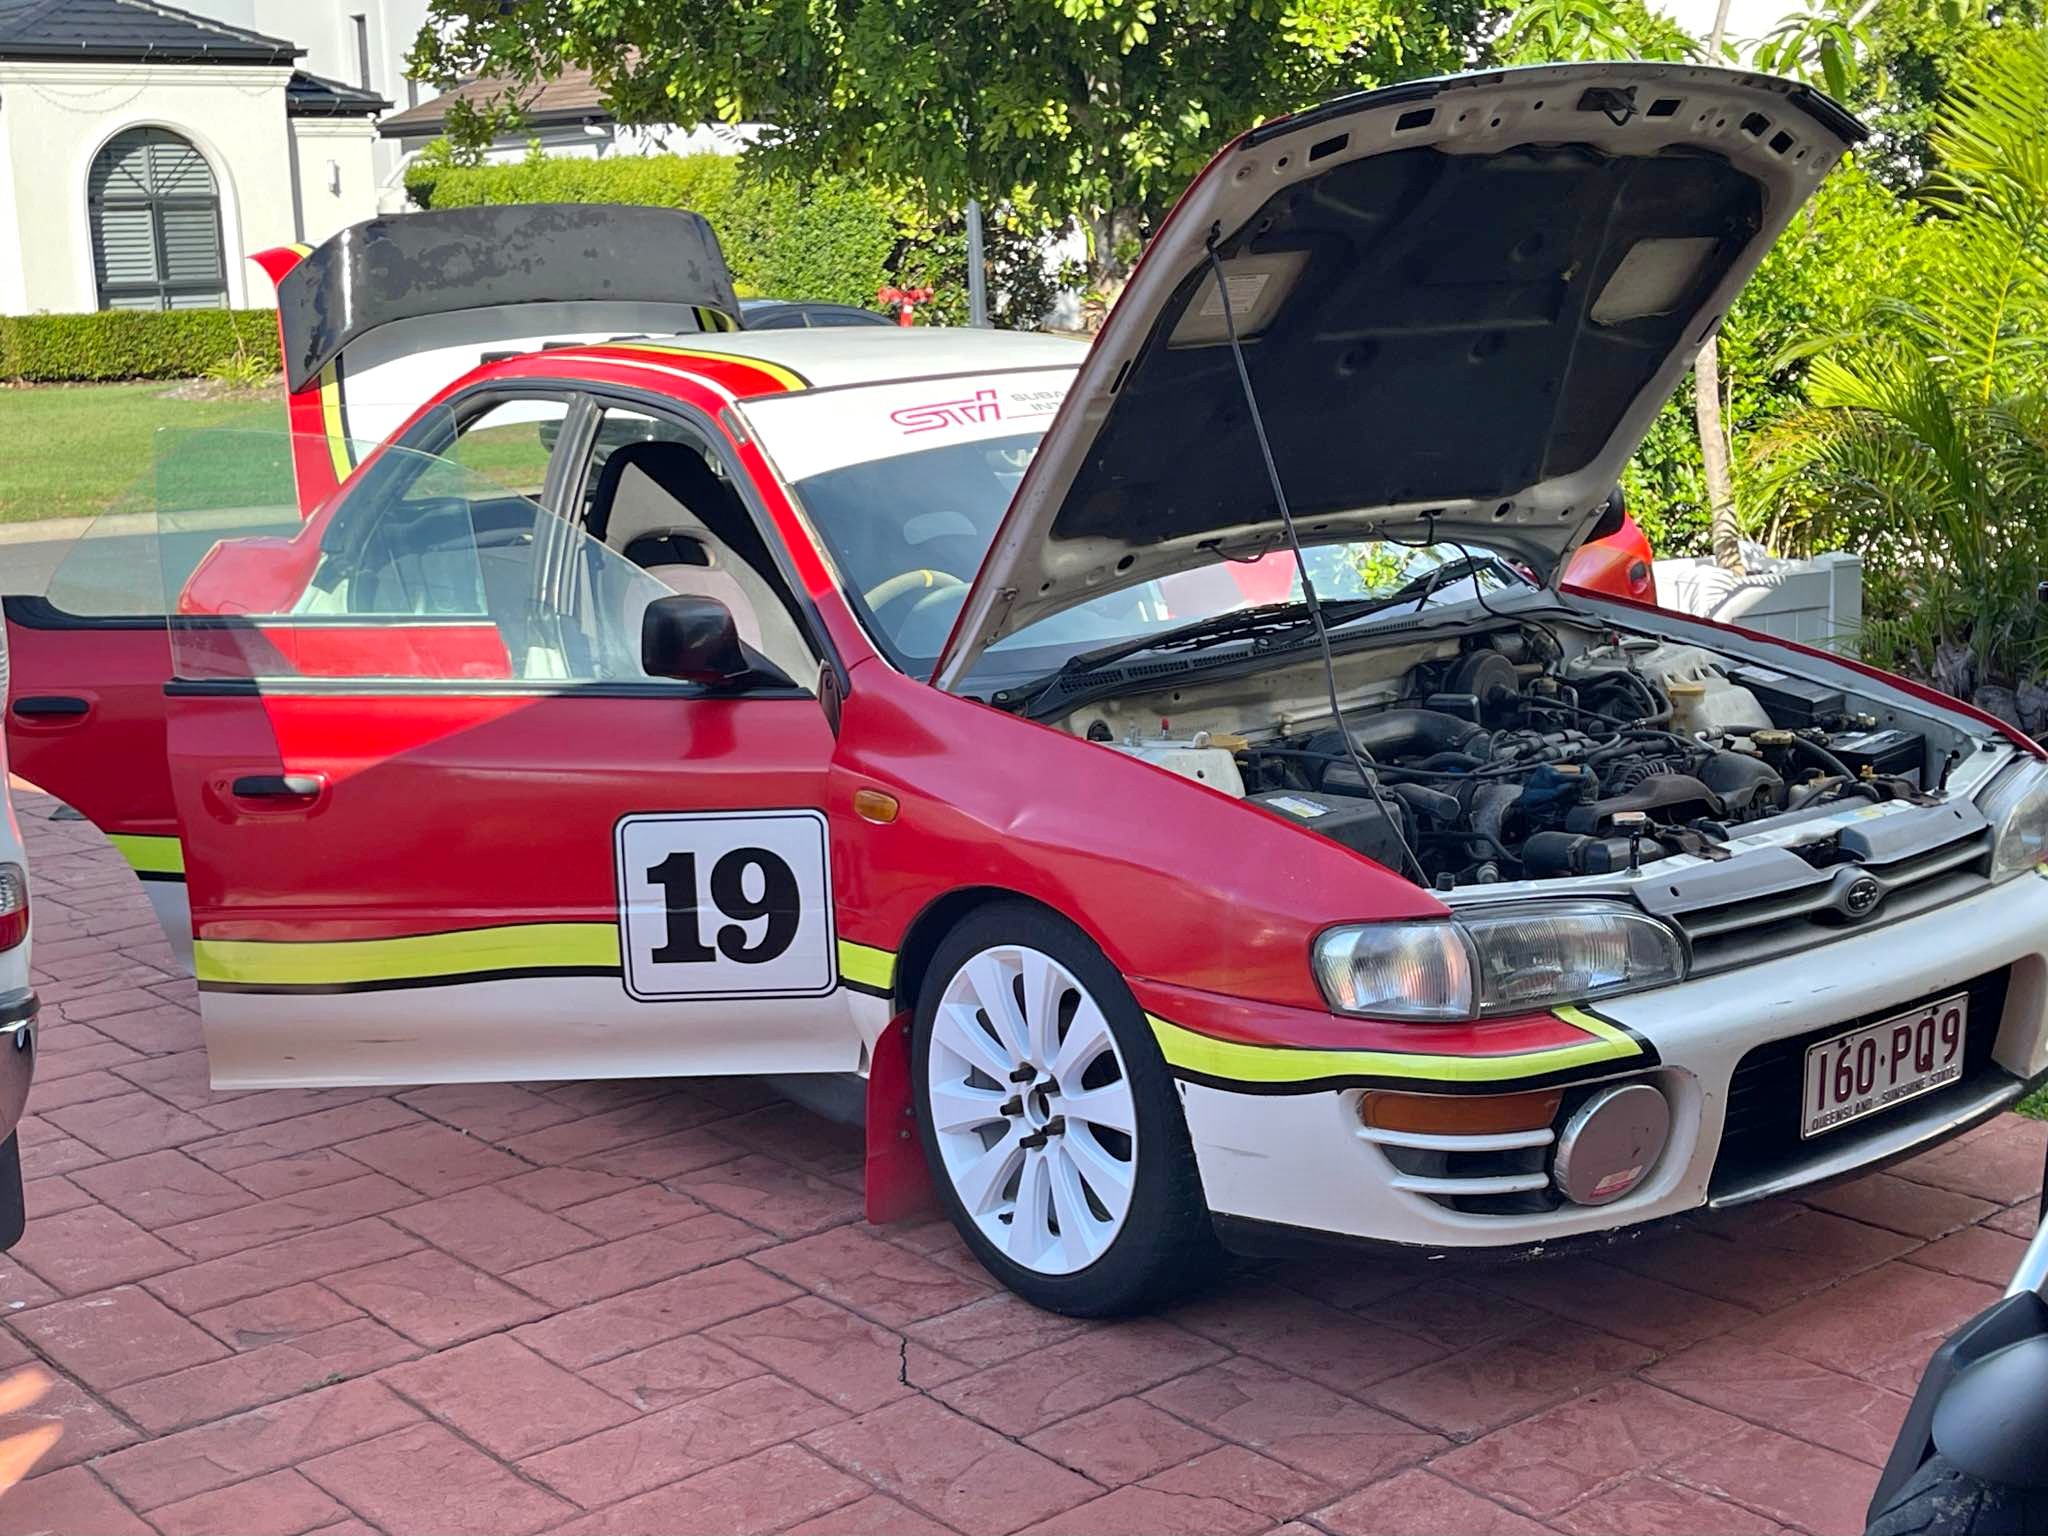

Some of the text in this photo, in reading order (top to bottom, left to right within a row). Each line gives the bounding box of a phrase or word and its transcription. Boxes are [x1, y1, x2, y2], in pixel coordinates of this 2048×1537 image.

[1010, 390, 1065, 402] SUBA
[646, 847, 801, 964] 19
[1811, 1097, 1873, 1131] QUEENSLAND
[1881, 1076, 1926, 1104] SUNSHINE
[1929, 1063, 1957, 1087] STATE
